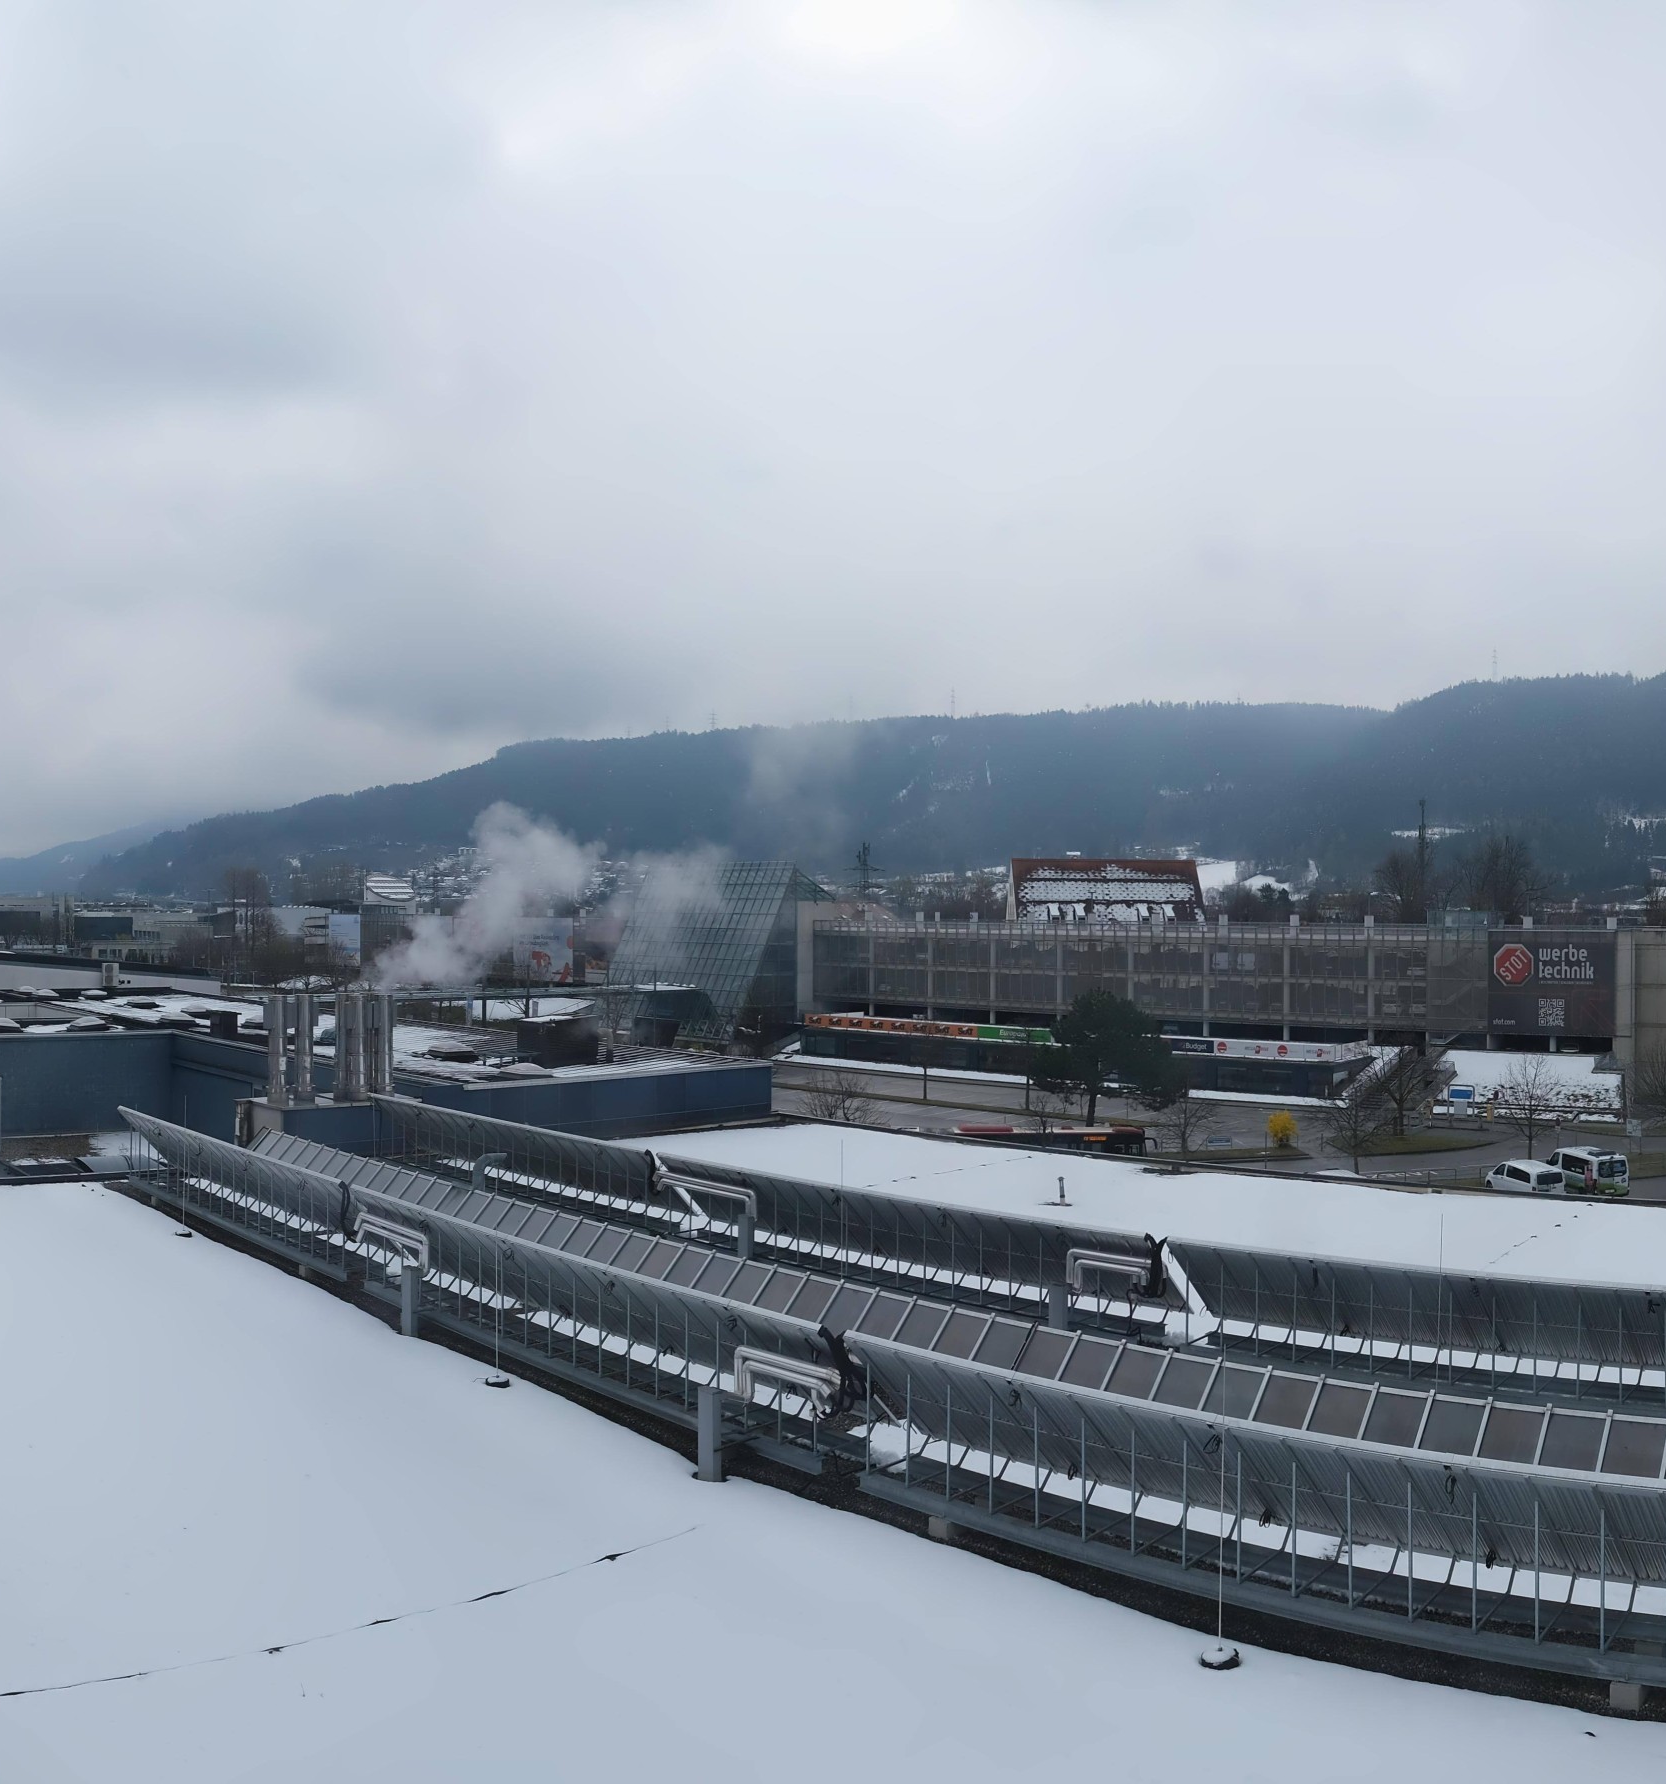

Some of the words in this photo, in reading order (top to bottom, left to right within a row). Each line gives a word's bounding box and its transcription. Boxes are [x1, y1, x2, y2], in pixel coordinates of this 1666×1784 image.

[1539, 943, 1588, 962] werbe
[1500, 949, 1529, 981] STOT
[1539, 961, 1594, 979] technik
[1186, 1042, 1207, 1051] Budget
